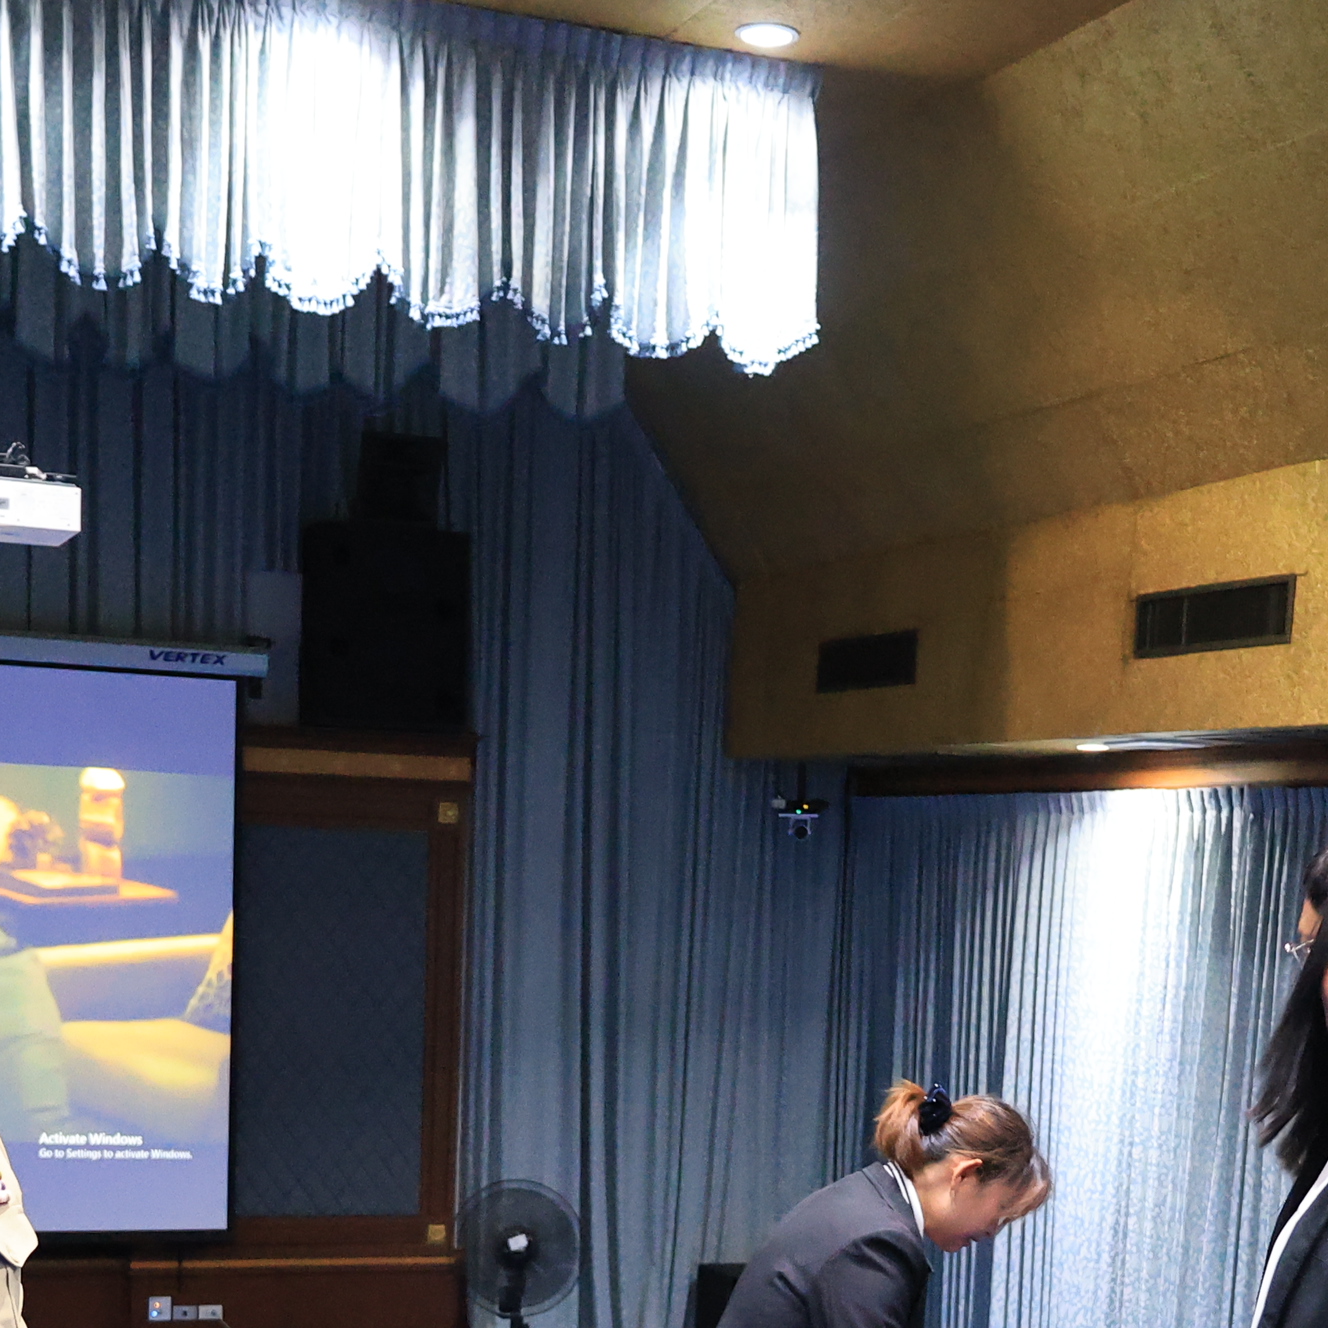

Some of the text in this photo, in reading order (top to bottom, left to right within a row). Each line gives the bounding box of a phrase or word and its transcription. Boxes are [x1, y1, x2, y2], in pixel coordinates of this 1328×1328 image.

[149, 649, 226, 665] VERTEX
[38, 1132, 143, 1146] Activate Windows
[38, 1148, 193, 1160] Go to Settings to activate Windows.
